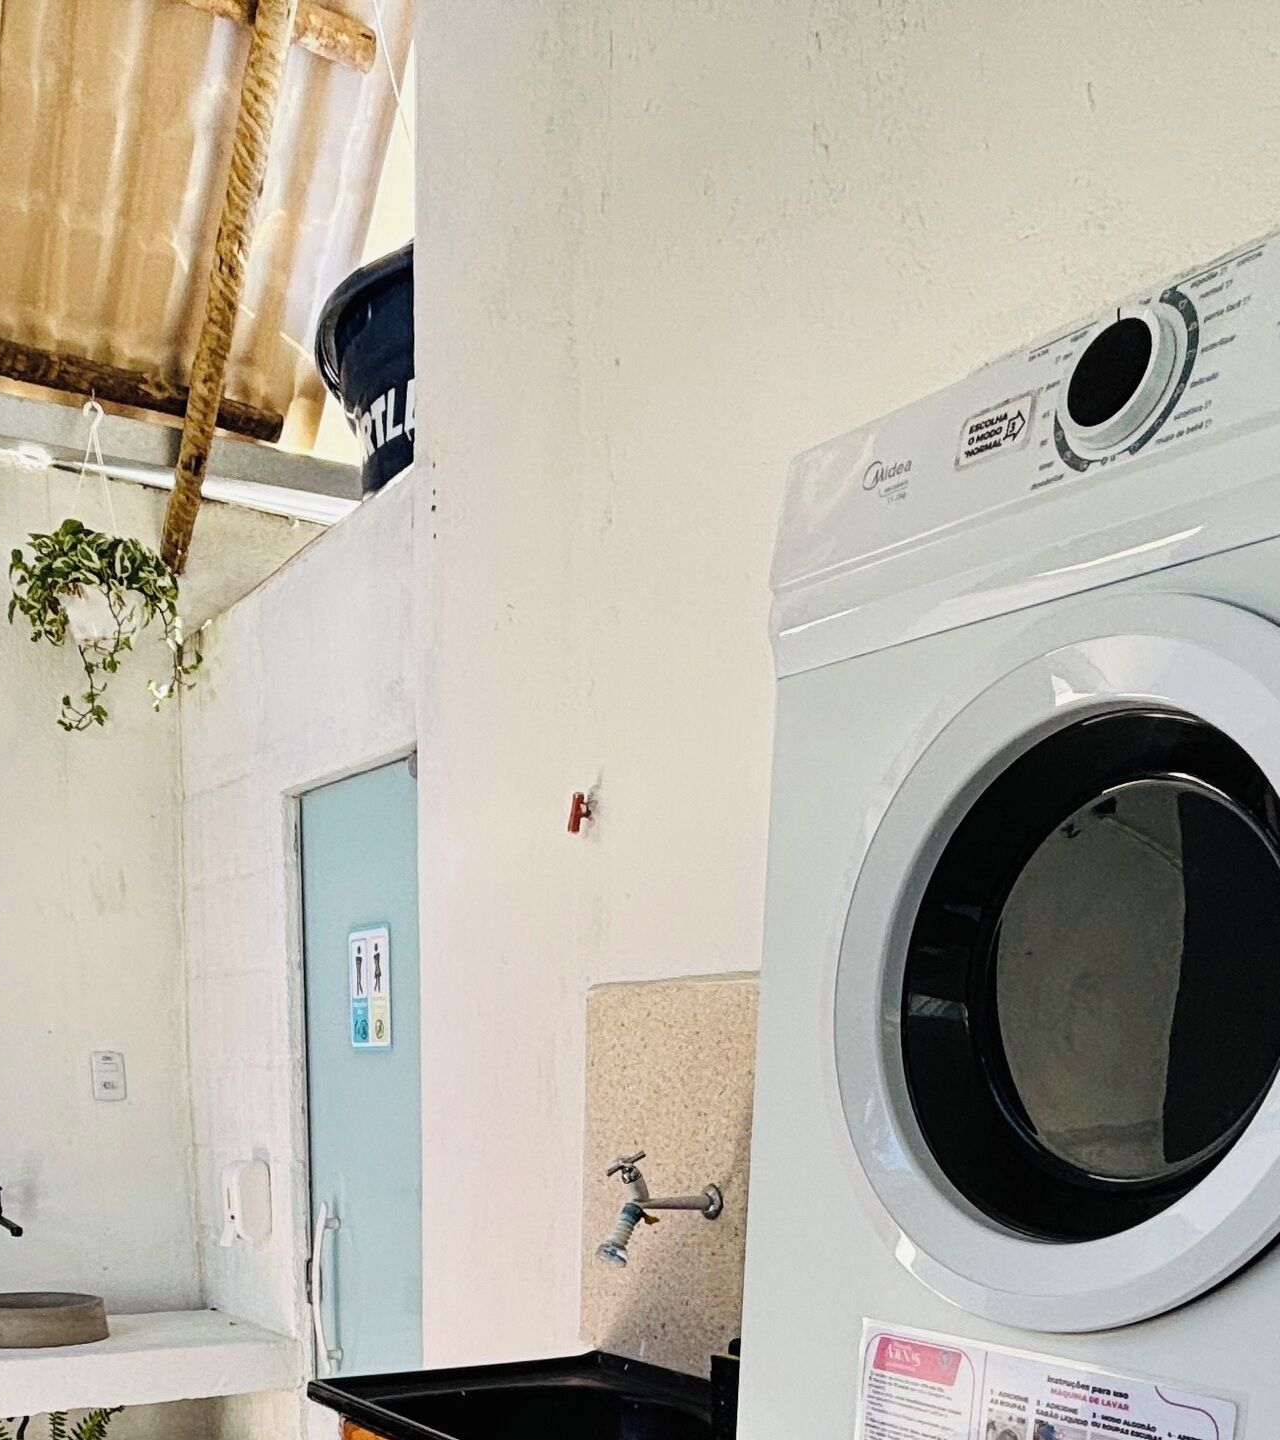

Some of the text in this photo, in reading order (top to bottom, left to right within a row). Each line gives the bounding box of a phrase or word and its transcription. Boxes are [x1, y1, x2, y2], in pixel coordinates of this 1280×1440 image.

[969, 412, 1008, 435] ESCOLHA
[968, 426, 1003, 446] O MODO
[863, 460, 912, 491] Midea
[1091, 1386, 1111, 1395] para
[1113, 1391, 1129, 1399] uso
[1088, 1396, 1099, 1405] DE
[1101, 1400, 1129, 1412] LAVAR
